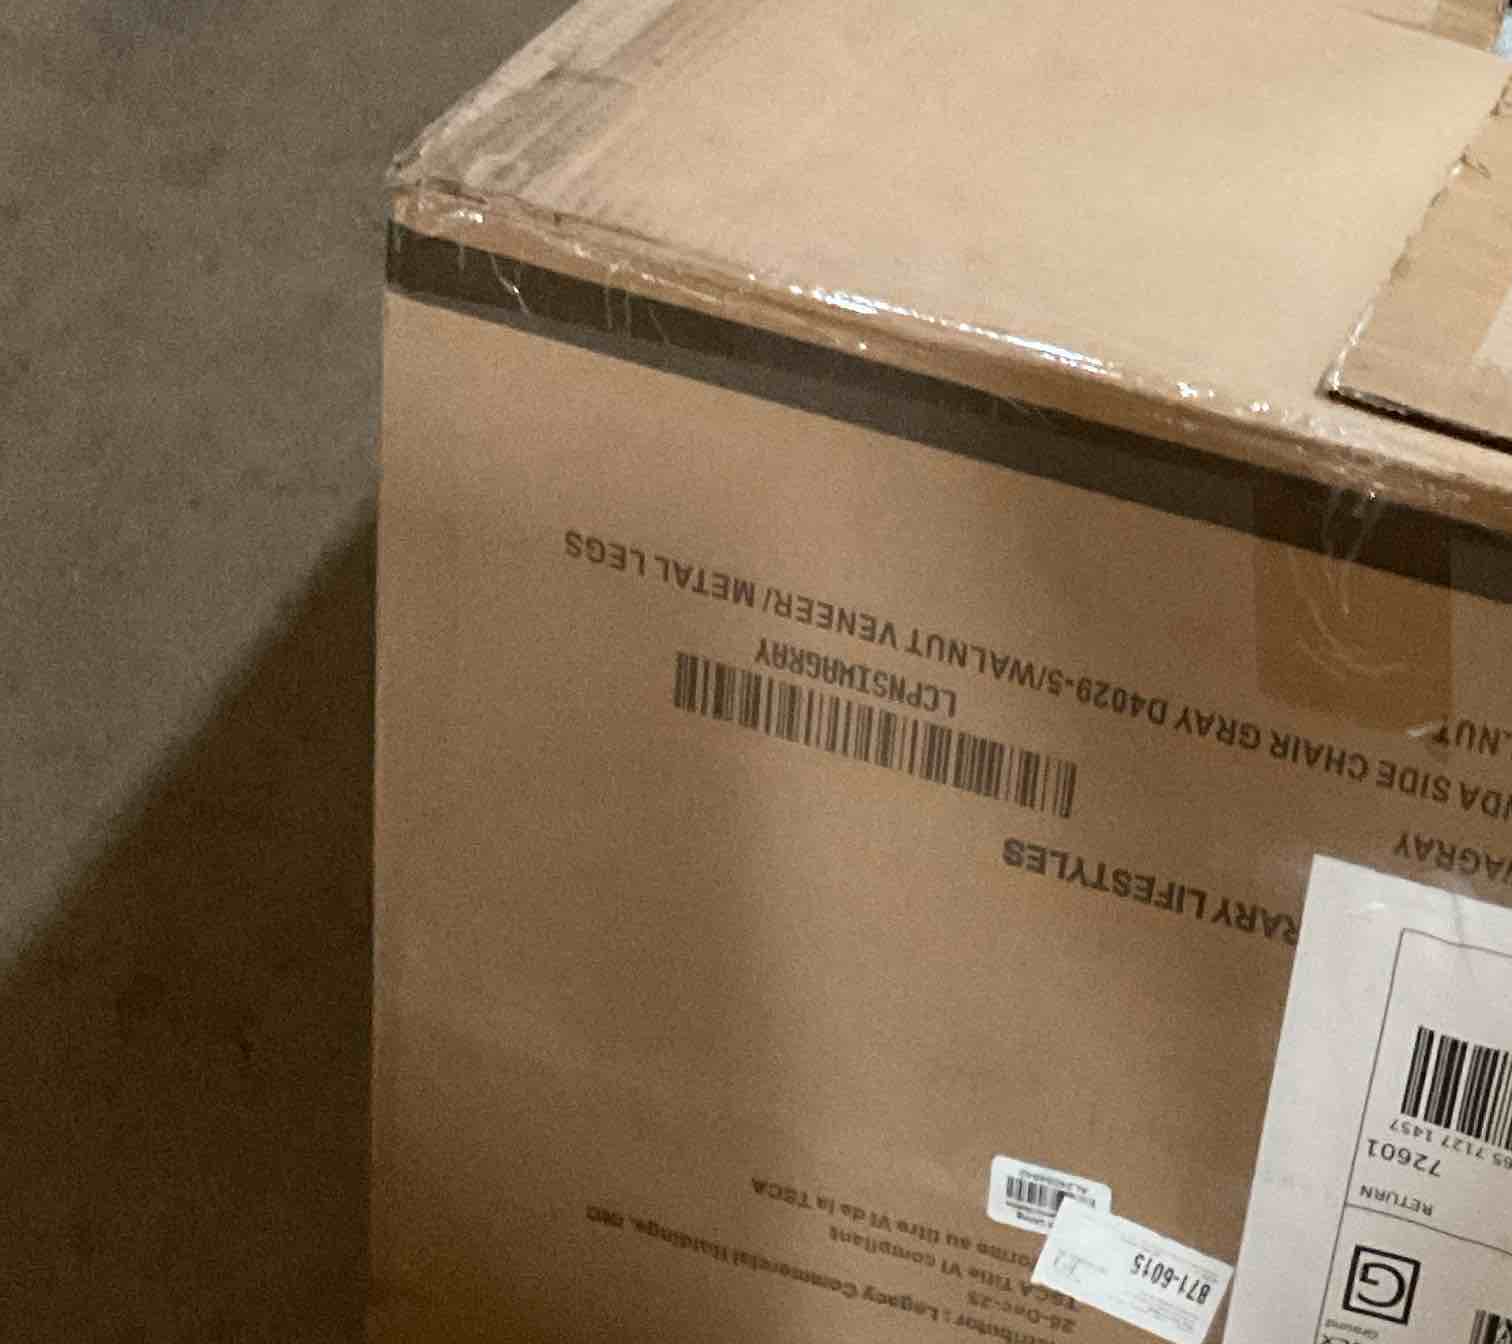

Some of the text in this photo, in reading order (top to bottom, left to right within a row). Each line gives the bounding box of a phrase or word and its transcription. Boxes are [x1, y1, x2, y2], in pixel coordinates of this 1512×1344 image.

[562, 530, 645, 576] LEGS
[651, 555, 754, 607] METAL
[754, 638, 956, 718] LCPNSIWAGRAY
[1173, 706, 1261, 750] GRAY
[1267, 728, 1369, 782] CHAIR
[1376, 760, 1451, 803] SIDE
[1002, 839, 1208, 918] LIFESTYLES
[1389, 1118, 1433, 1142] 1457
[1441, 1134, 1484, 1158] 7127
[1367, 1139, 1440, 1177] 72601
[838, 1203, 866, 1221] de
[1359, 1185, 1433, 1216] RETURN
[870, 1212, 892, 1230] VI
[829, 1225, 936, 1267] compliant
[939, 1260, 962, 1278] VI
[968, 1267, 1012, 1291] Title
[1132, 1254, 1211, 1304] 871-6015
[1356, 1262, 1406, 1308] G
[862, 1286, 939, 1320] Legacy
[1325, 1318, 1378, 1339] Ground
